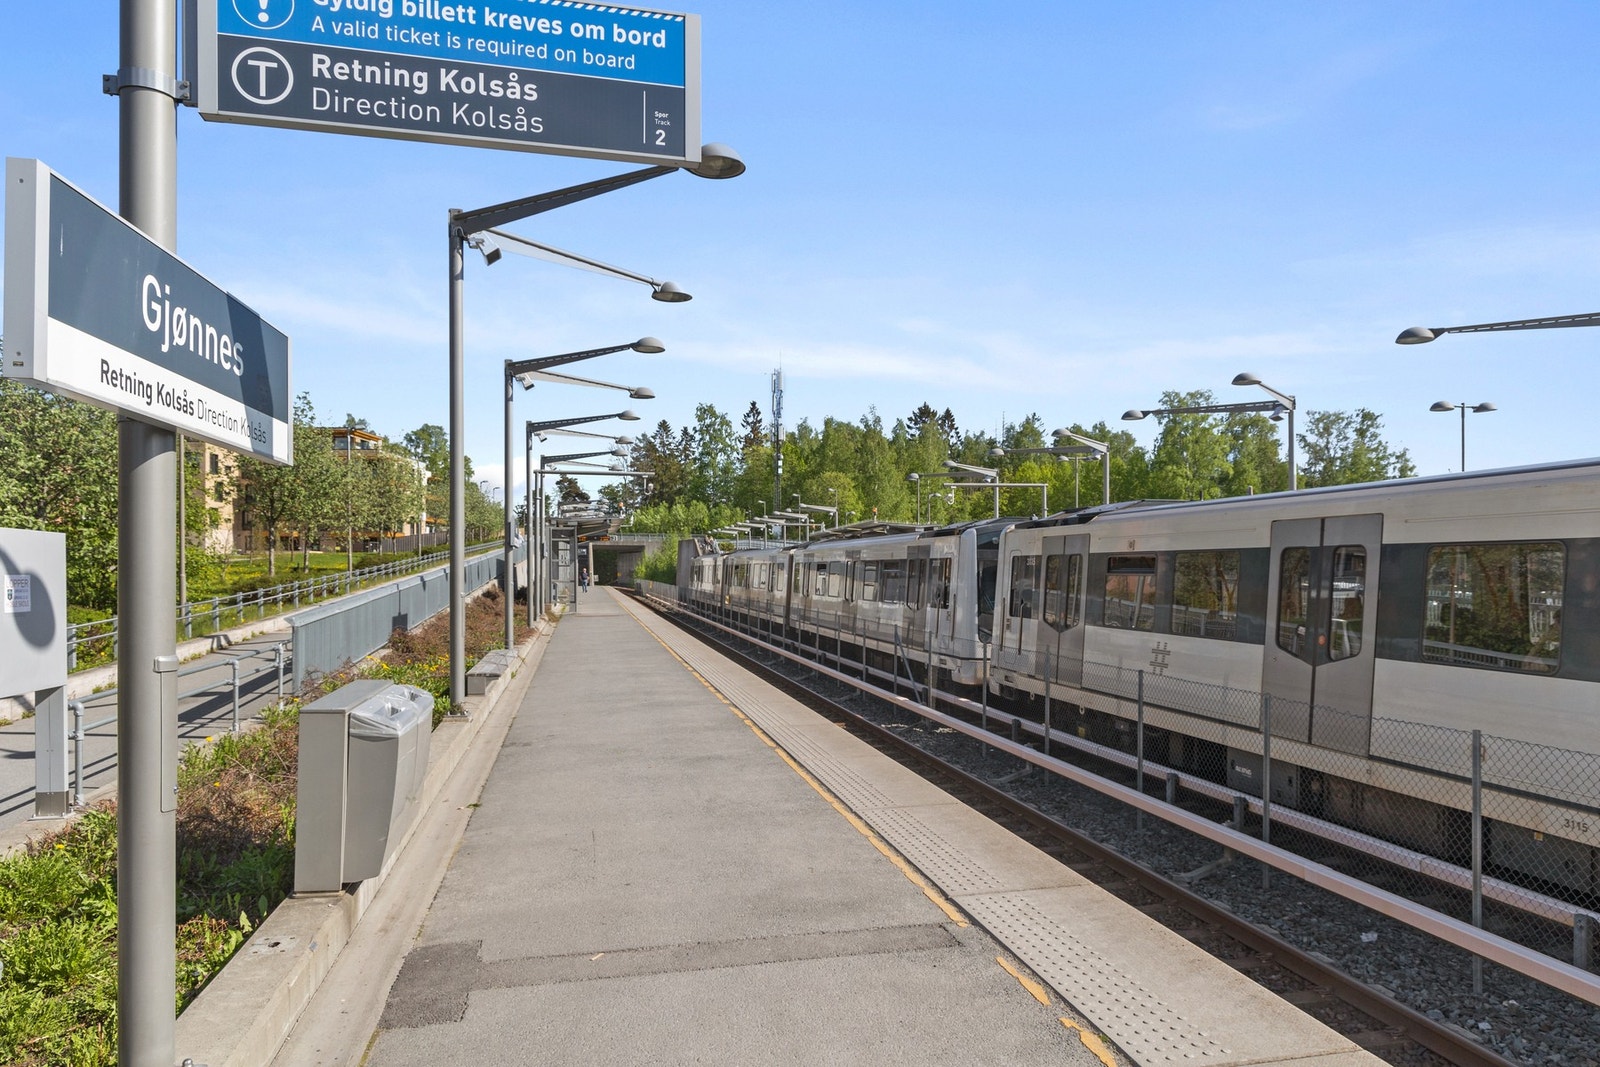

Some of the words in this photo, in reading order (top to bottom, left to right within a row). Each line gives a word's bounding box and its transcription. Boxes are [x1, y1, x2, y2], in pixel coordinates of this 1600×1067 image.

[311, 16, 325, 33] A
[331, 20, 379, 39] valid
[386, 25, 441, 47] ticket
[447, 31, 461, 49] is
[467, 37, 548, 59] required
[554, 48, 577, 63] on
[583, 48, 636, 70] board
[313, 0, 393, 18] ydig
[402, 0, 477, 25] billett
[484, 7, 563, 35] kreves
[570, 22, 605, 41] om
[613, 23, 667, 48] bord
[247, 59, 278, 97] T
[312, 53, 428, 95] Retning
[440, 67, 538, 102] Kolsås
[312, 87, 441, 123] Direction
[452, 102, 544, 133] Kolsås
[654, 111, 669, 119] Spor
[654, 118, 671, 126] Track
[655, 129, 666, 146] 2
[142, 274, 244, 377] Gjønnes
[100, 358, 153, 406] Retning
[156, 381, 195, 416] Kolsås
[197, 398, 238, 433] Direction
[240, 416, 267, 444] Kolsås
[1563, 818, 1589, 833] 3115
